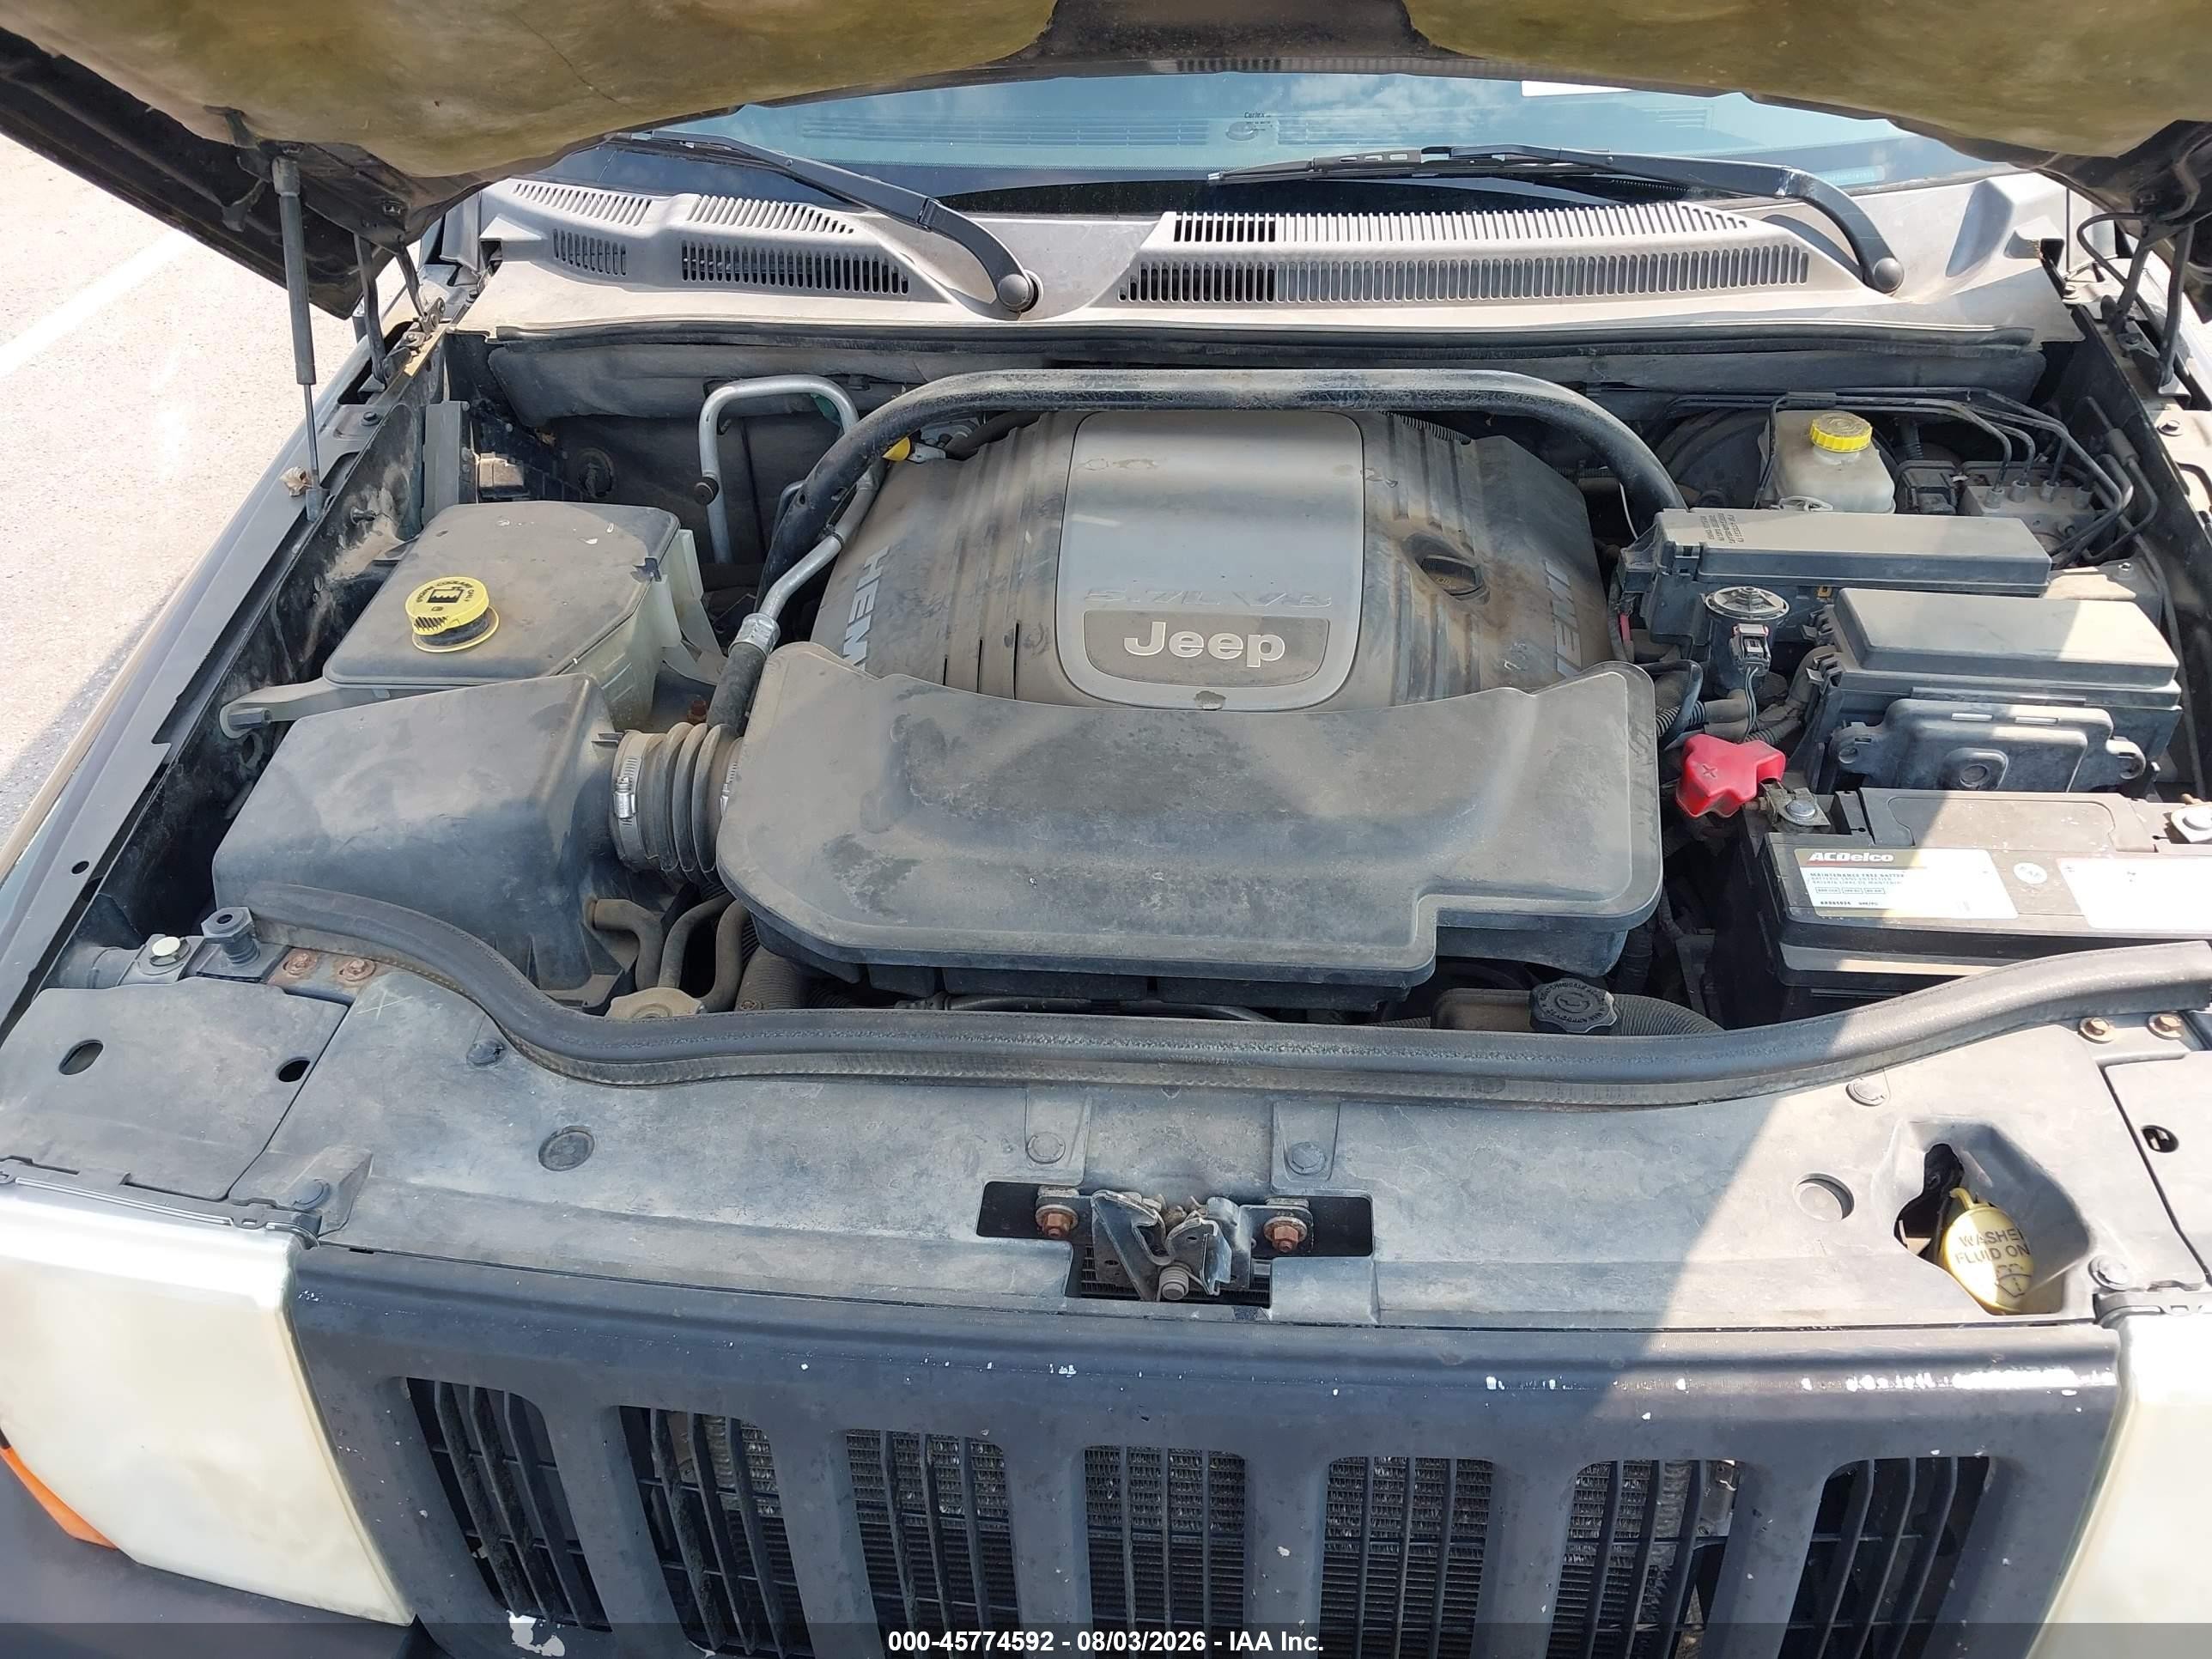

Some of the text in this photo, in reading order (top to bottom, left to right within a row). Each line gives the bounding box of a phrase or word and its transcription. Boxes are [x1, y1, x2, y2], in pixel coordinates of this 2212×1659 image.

[842, 544, 891, 672] HEM
[1123, 621, 1285, 668] Jeep
[1808, 851, 1894, 862] ACDelco
[1954, 1242, 2031, 1265] FLUID ON
